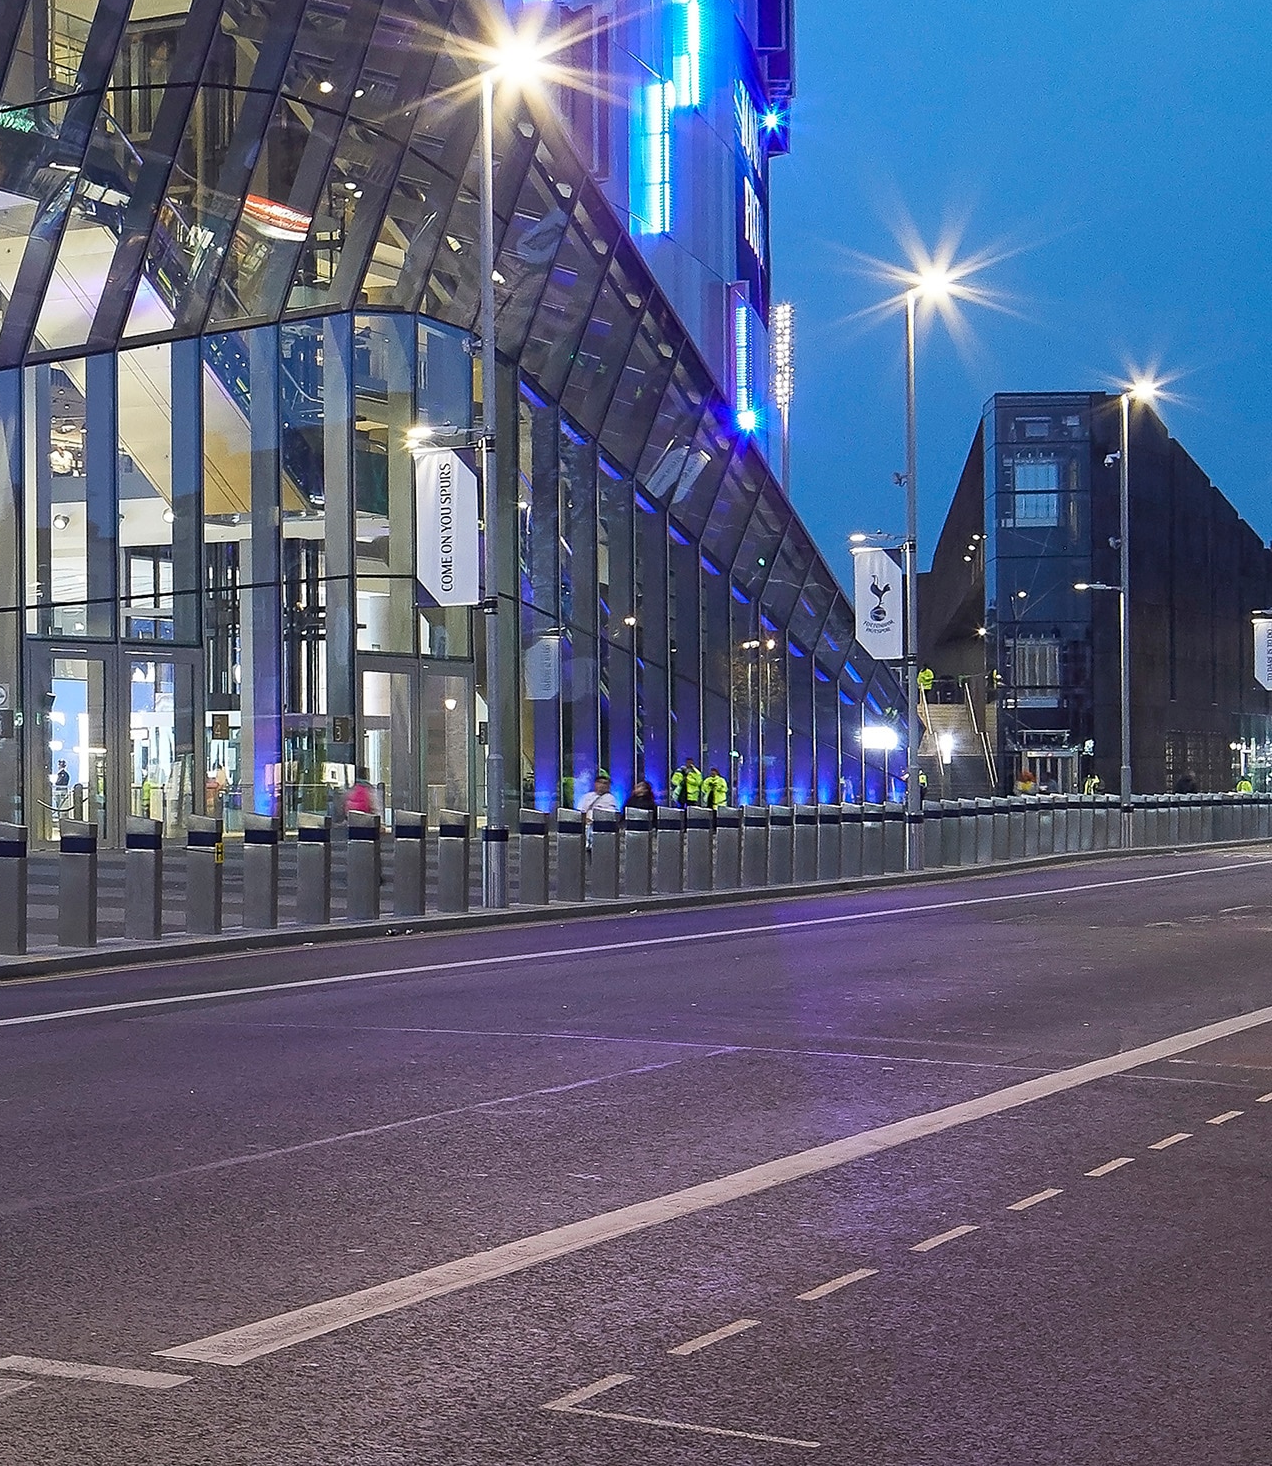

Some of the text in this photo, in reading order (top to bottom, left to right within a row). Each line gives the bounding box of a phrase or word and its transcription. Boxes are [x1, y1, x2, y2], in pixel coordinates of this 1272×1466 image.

[439, 462, 454, 592] COME ON YOU SPURS
